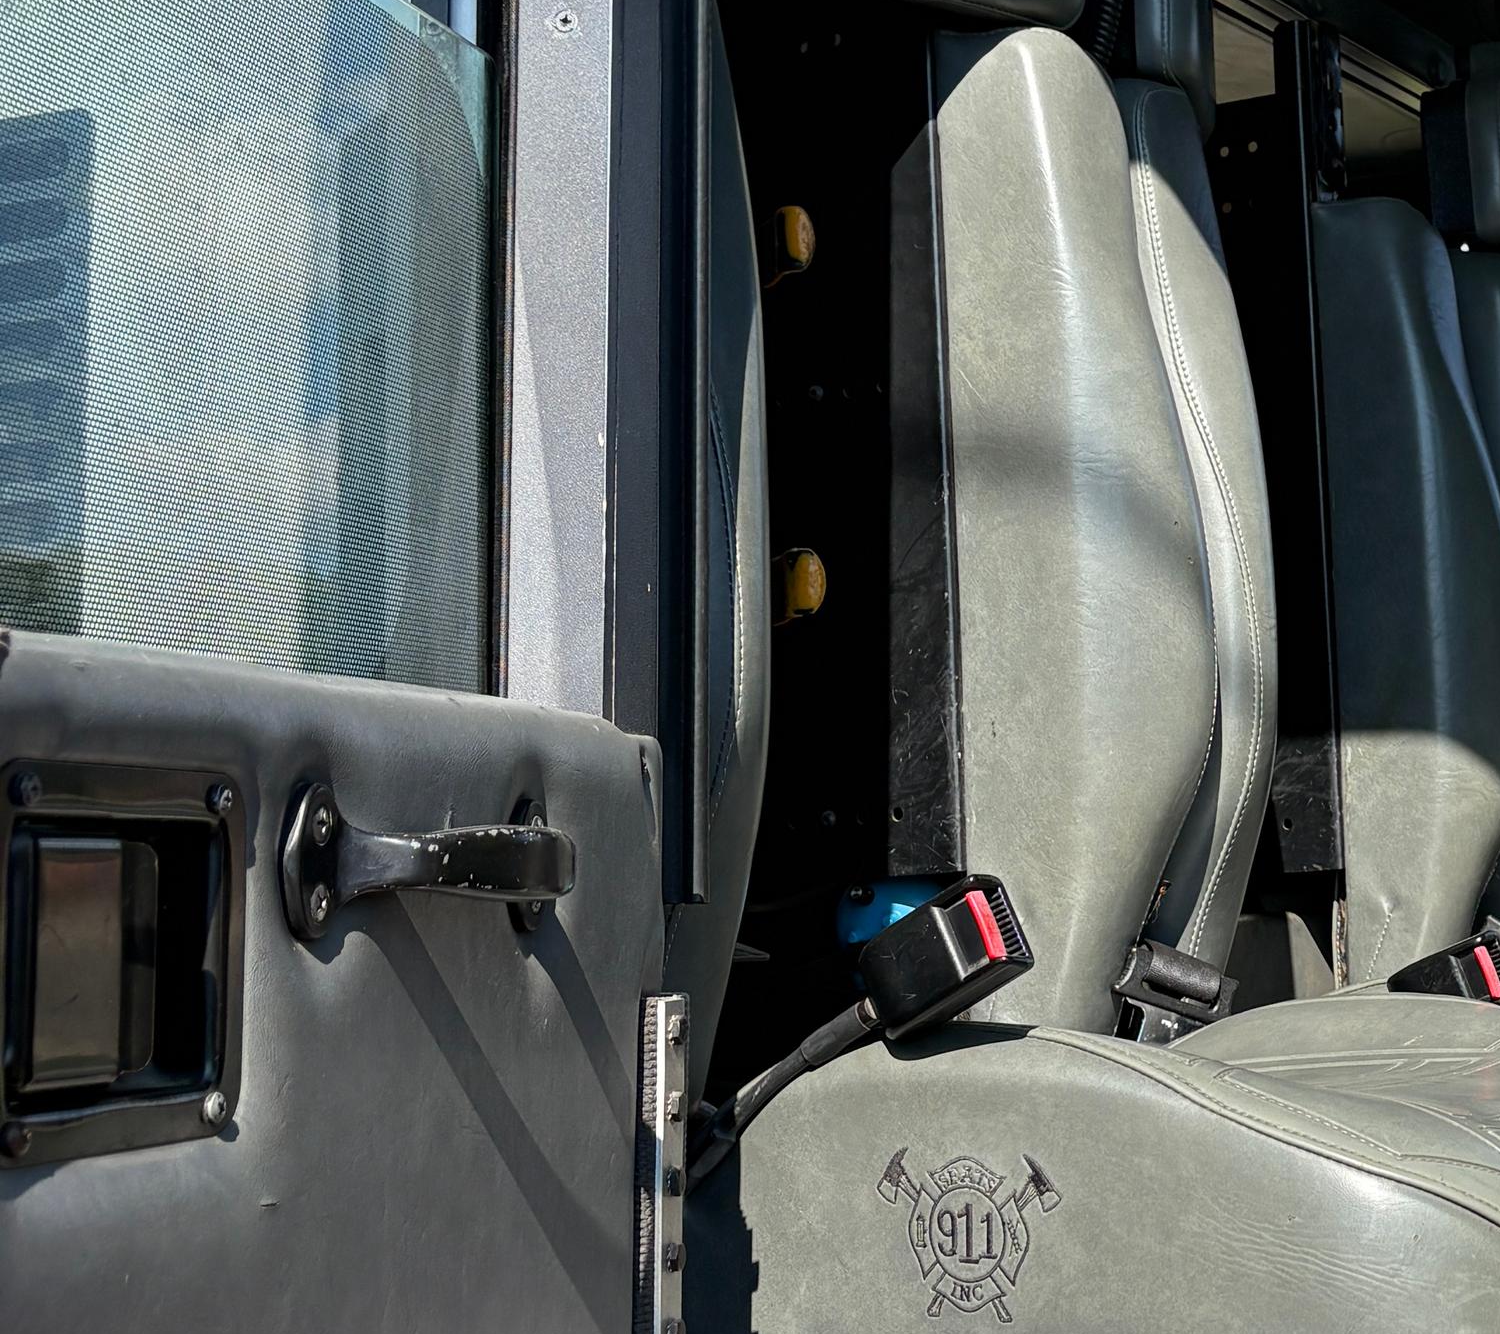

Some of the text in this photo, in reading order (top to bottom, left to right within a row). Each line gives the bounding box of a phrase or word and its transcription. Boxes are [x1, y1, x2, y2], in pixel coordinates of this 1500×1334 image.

[937, 1166, 997, 1194] SEATS
[936, 1202, 998, 1264] 911
[951, 1283, 984, 1303] INC
